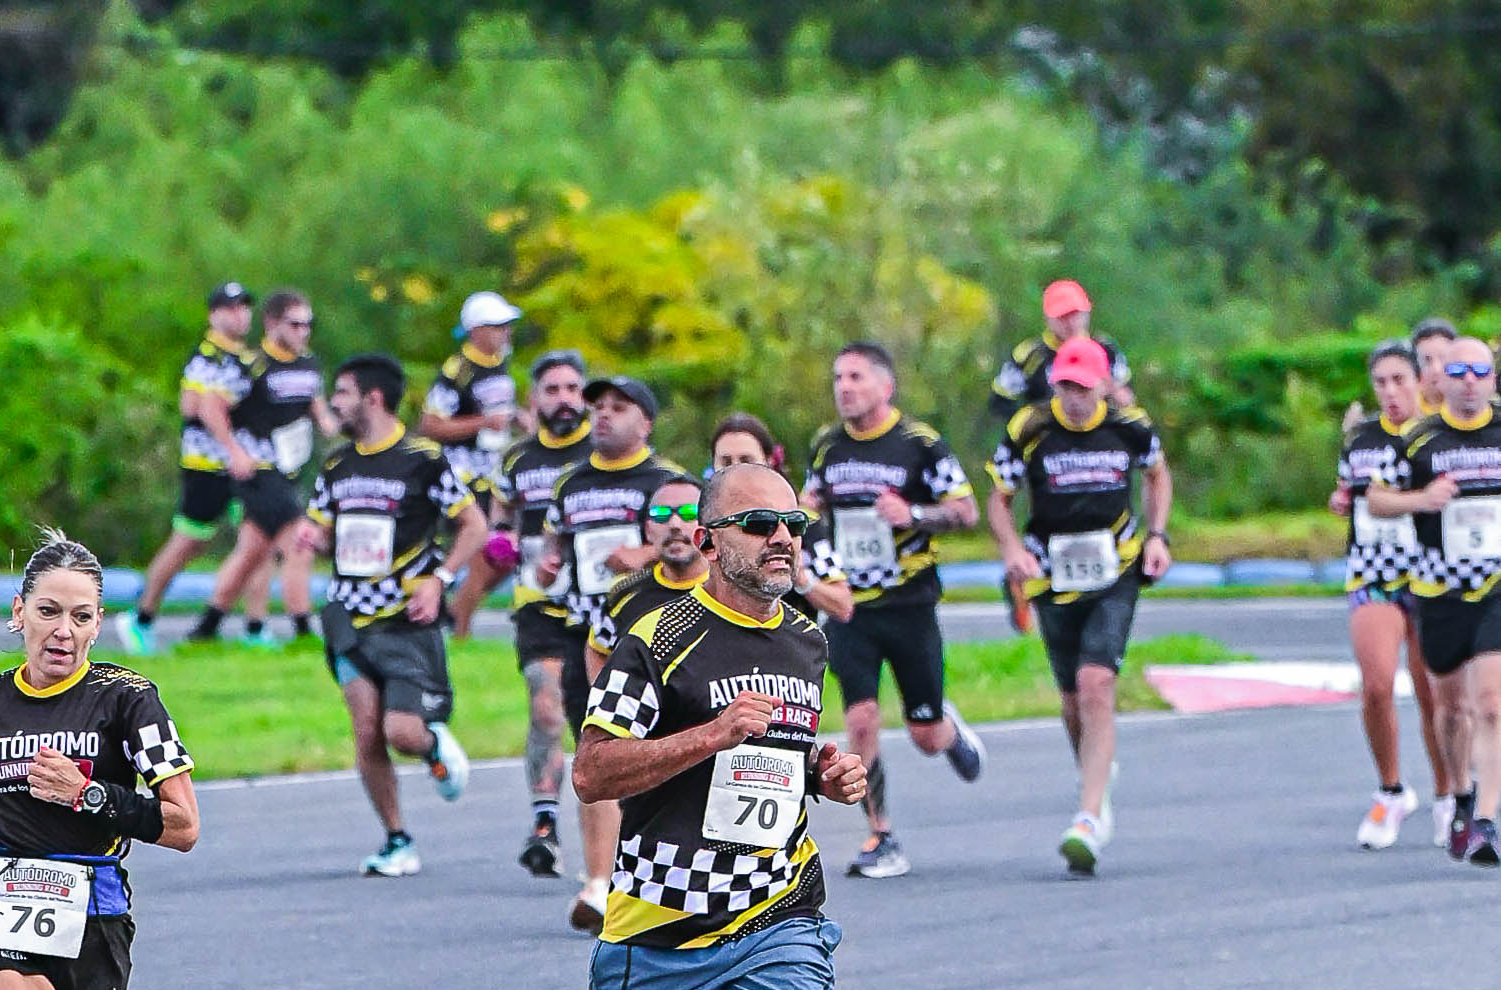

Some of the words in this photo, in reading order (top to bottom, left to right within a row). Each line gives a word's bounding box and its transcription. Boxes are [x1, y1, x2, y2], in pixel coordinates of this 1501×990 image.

[786, 707, 812, 728] RACE
[730, 752, 795, 777] AUTÓDROMO
[734, 795, 779, 830] 70
[3, 864, 76, 888] AUTÓDROMO
[10, 906, 56, 938] 76
